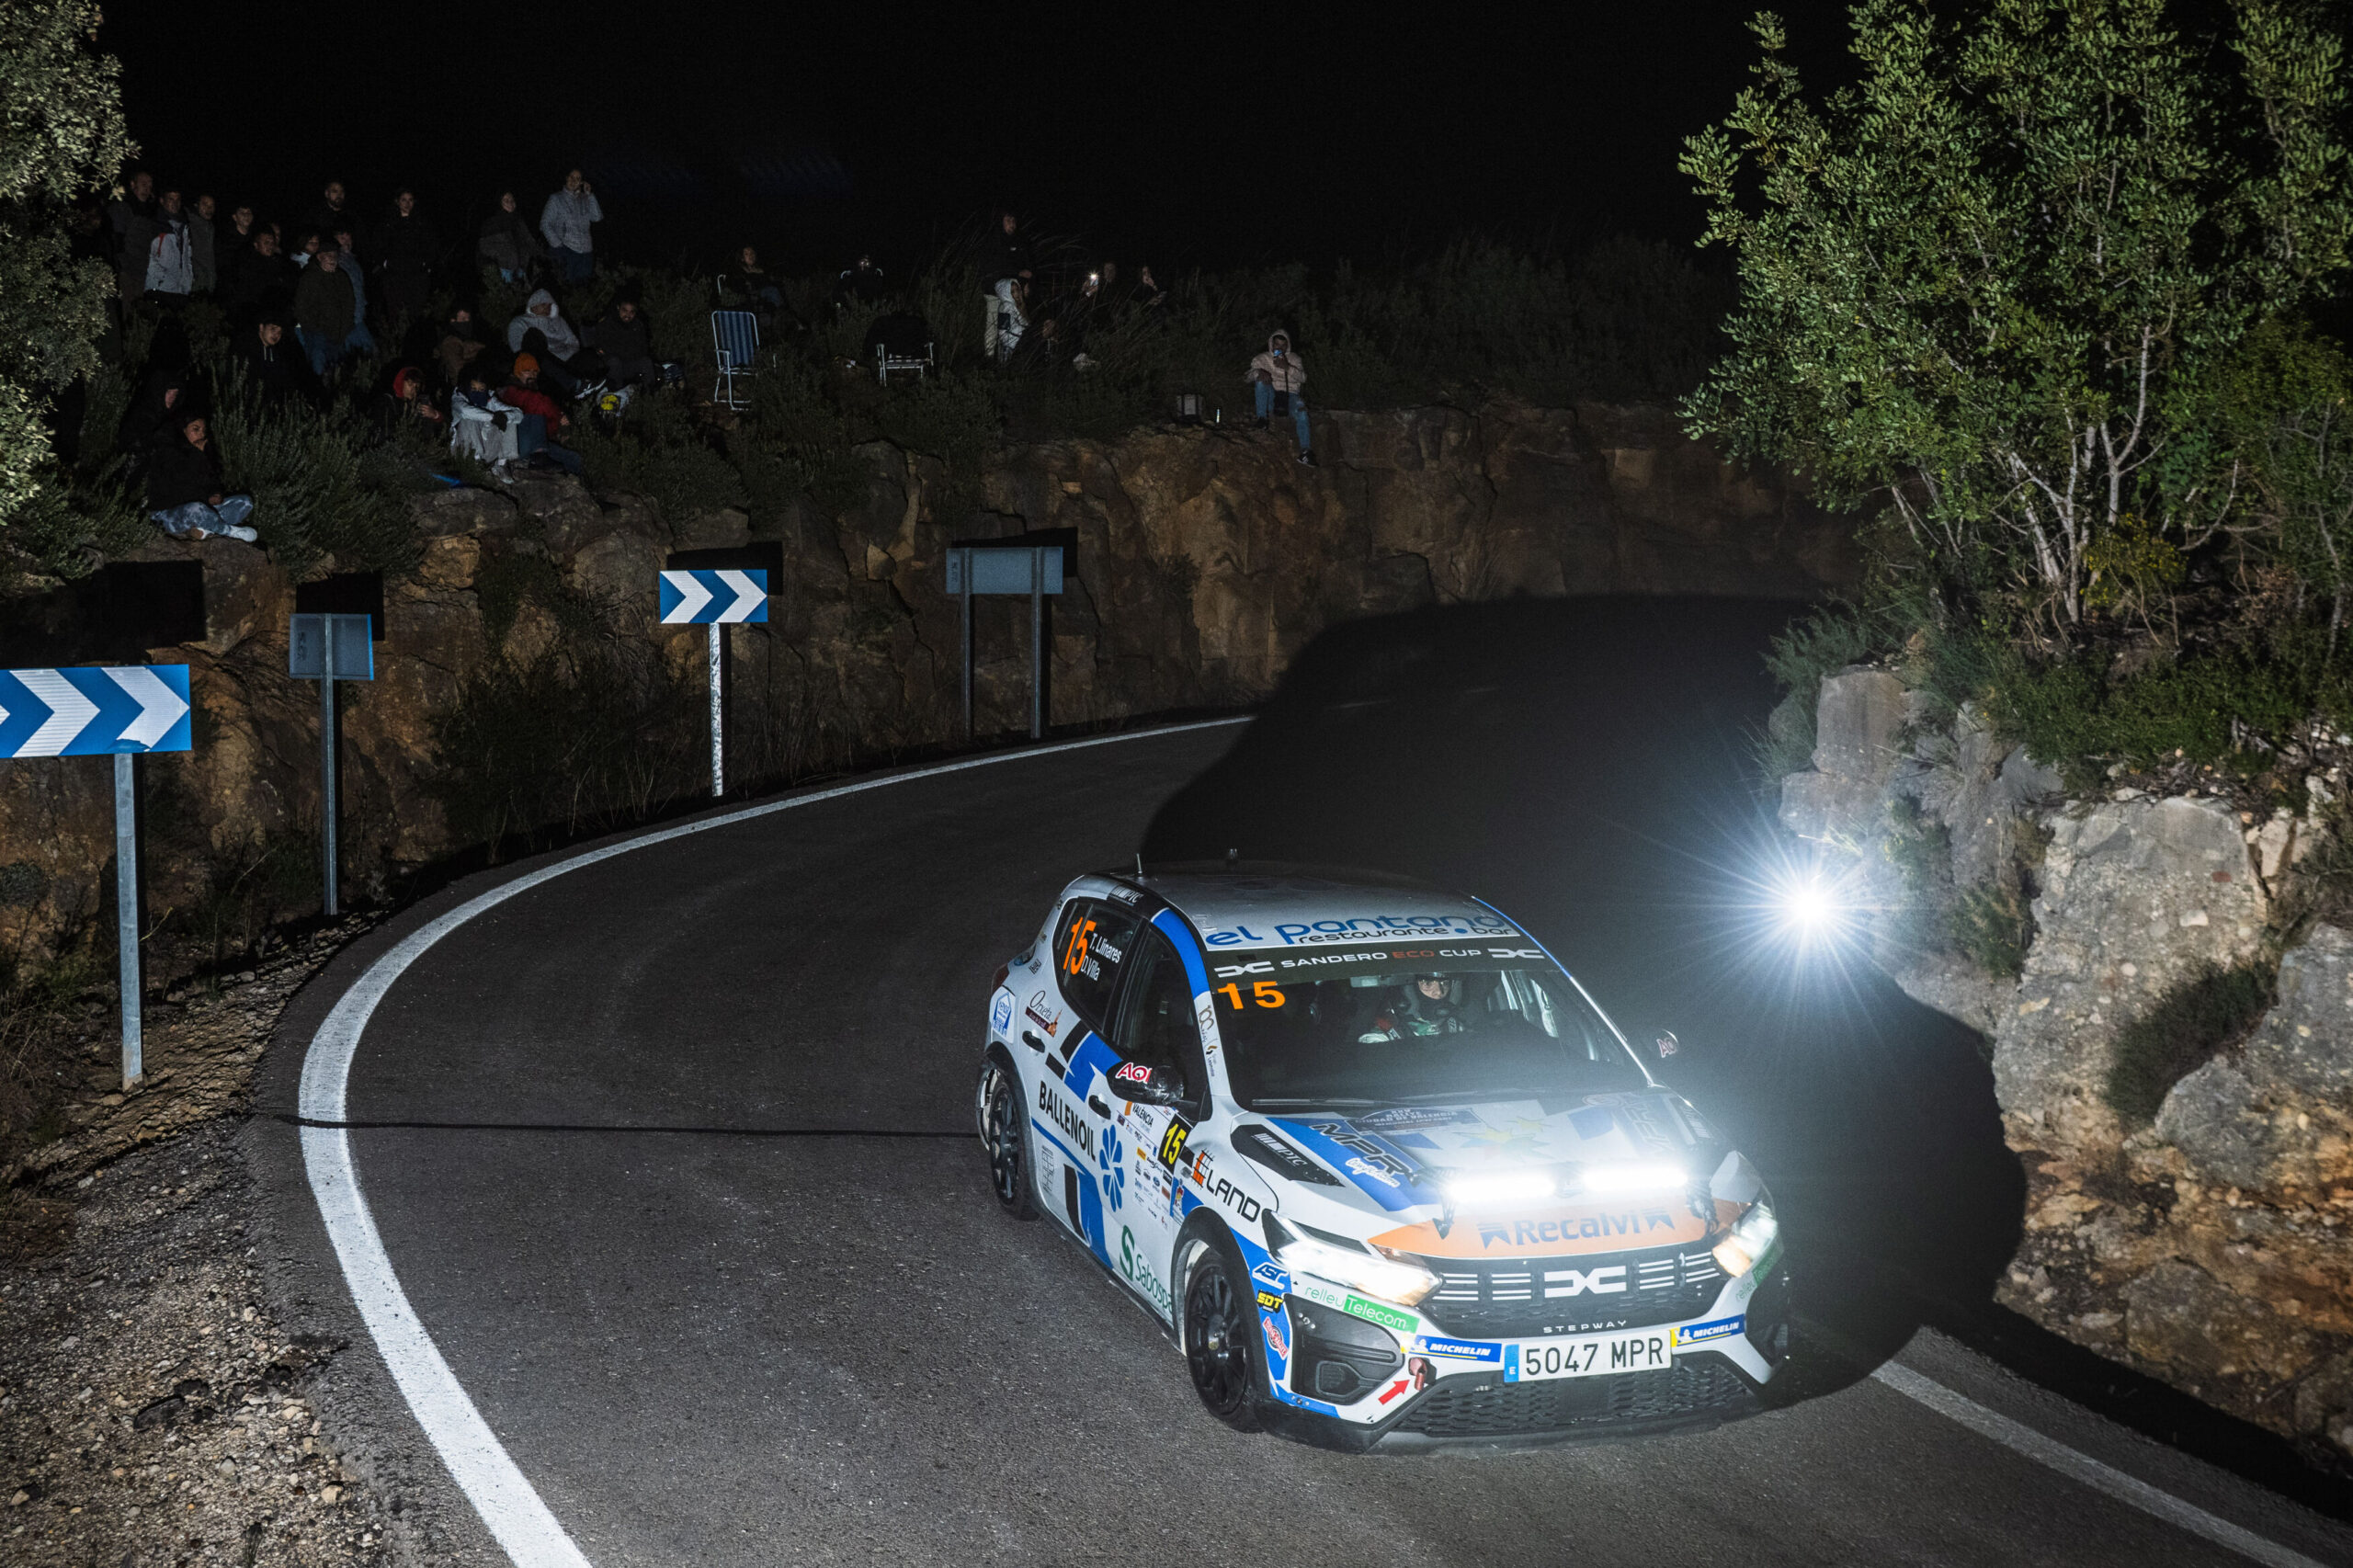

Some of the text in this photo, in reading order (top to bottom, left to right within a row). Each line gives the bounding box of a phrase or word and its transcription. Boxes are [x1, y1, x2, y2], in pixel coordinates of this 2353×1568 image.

[1063, 916, 1097, 975] 15
[1205, 915, 1506, 946] el pantano
[1299, 926, 1513, 944] restaurante bar
[1280, 949, 1482, 968] SANDERO ECO CUP
[1217, 981, 1286, 1010] 15
[1039, 1080, 1096, 1162] BALLENOIL
[1163, 1123, 1187, 1165] 15
[1309, 1122, 1415, 1177] MPR
[1206, 1169, 1261, 1222] LAND
[1513, 1210, 1642, 1246] Recalvi
[1304, 1286, 1407, 1330] relleu Telecom
[1543, 1320, 1627, 1334] STEPWAY
[1693, 1322, 1740, 1338] MICHELIN
[1429, 1342, 1491, 1357] MICHELIN
[1508, 1336, 1664, 1376] E 5047 MPR
